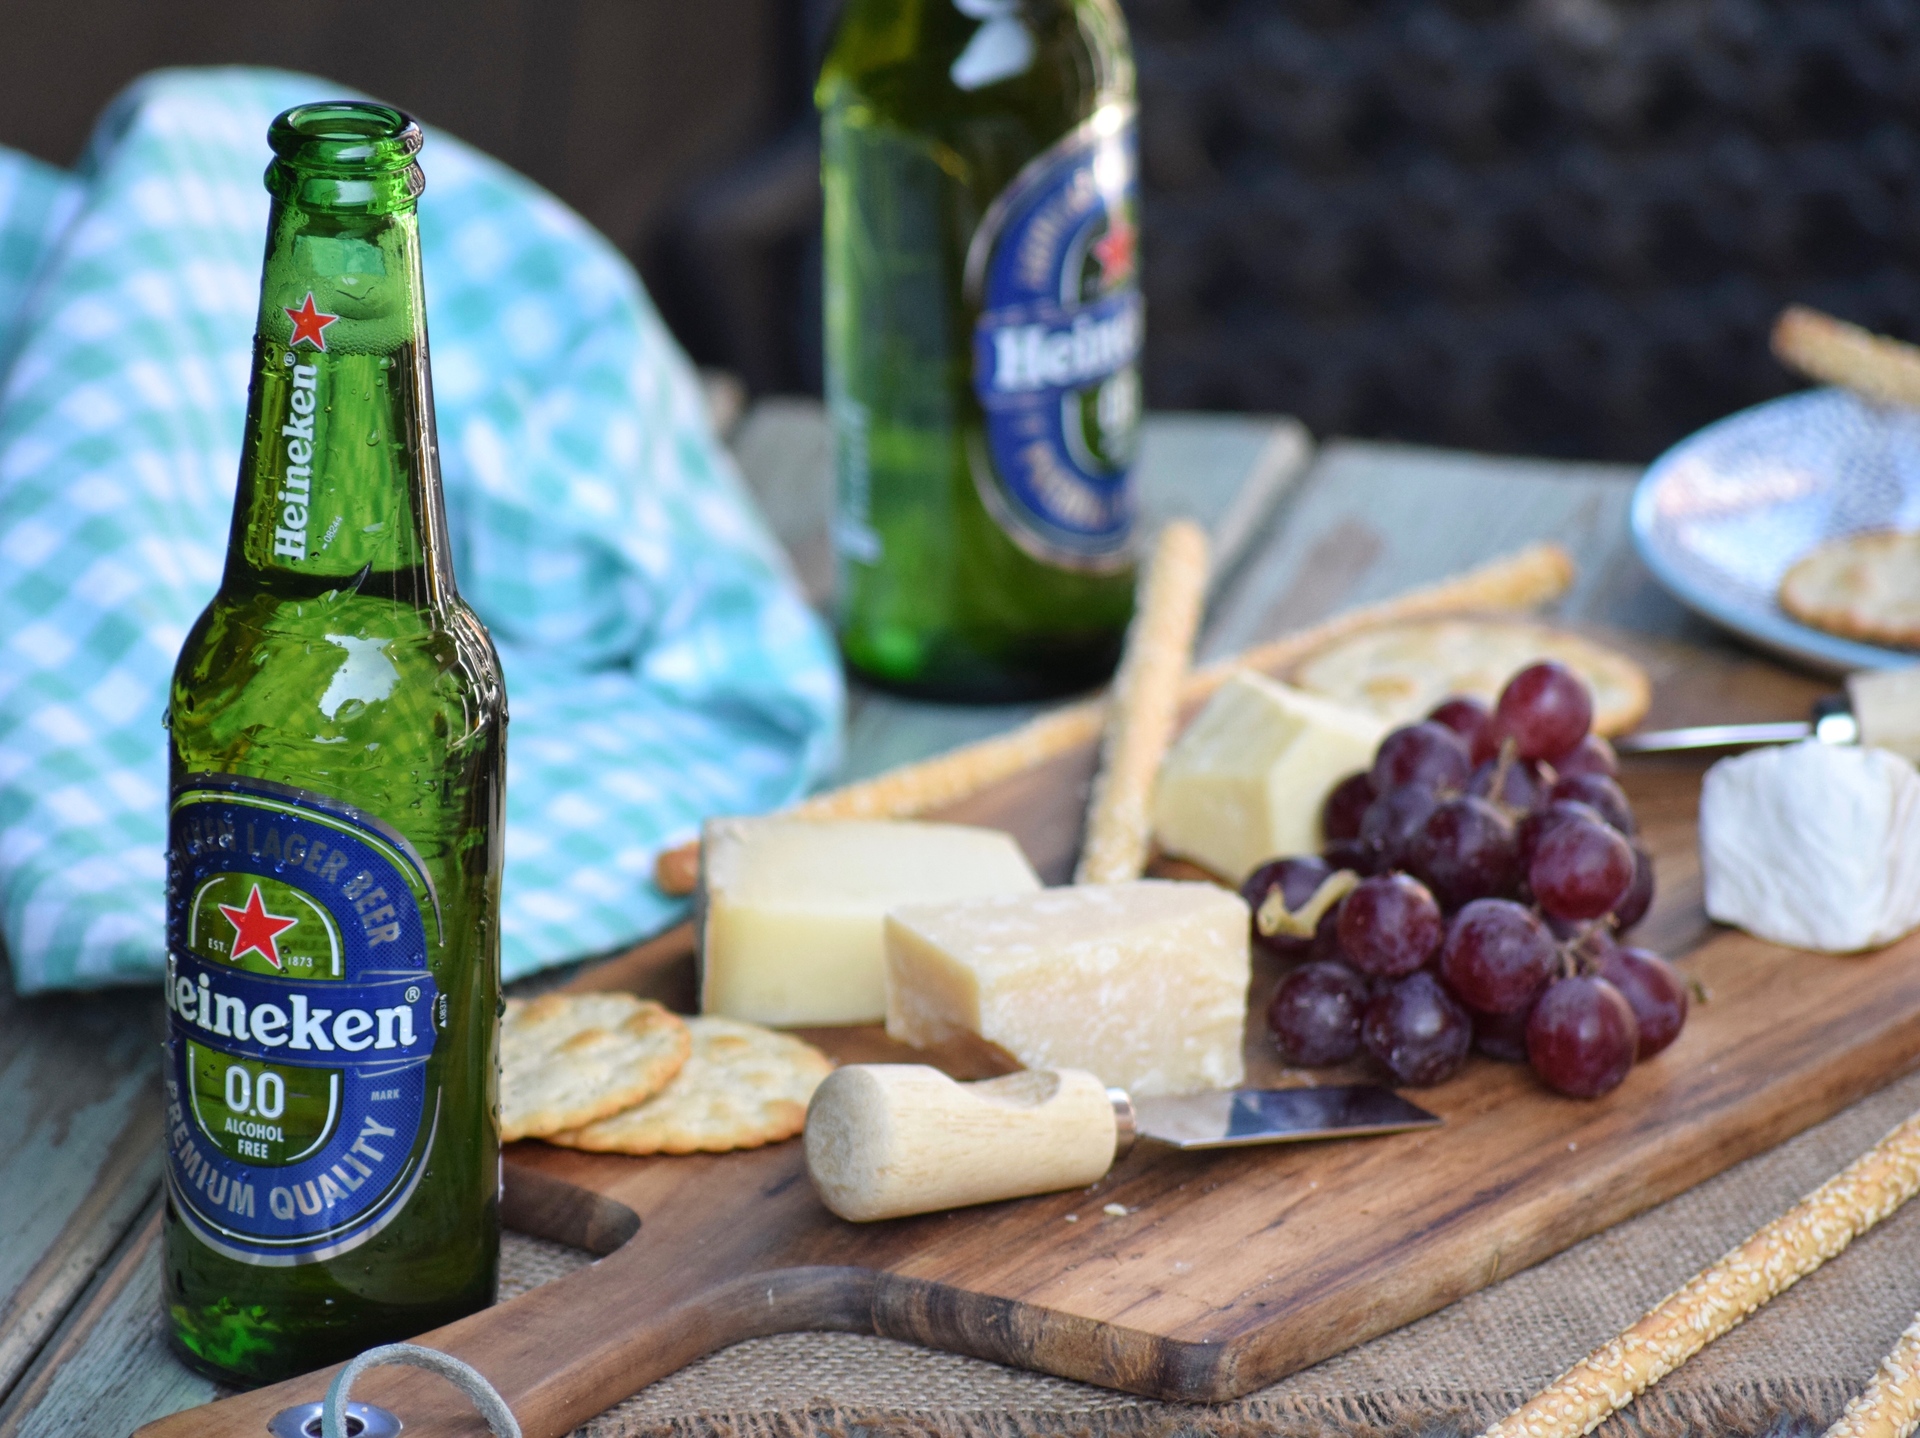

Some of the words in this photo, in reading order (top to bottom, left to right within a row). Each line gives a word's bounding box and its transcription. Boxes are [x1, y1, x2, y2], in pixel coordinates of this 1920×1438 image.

[274, 363, 317, 561] Heineken
[247, 822, 349, 884] LAGER
[342, 869, 400, 949] BEER
[208, 937, 227, 954] EST.
[287, 955, 313, 968] 1873
[224, 1063, 285, 1119] 0.0
[371, 1088, 400, 1102] MARK
[224, 1117, 285, 1143] ALCOHOL
[166, 1080, 255, 1219] PREMIUM
[268, 1115, 396, 1222] QUALITY
[237, 1138, 269, 1160] FREE
